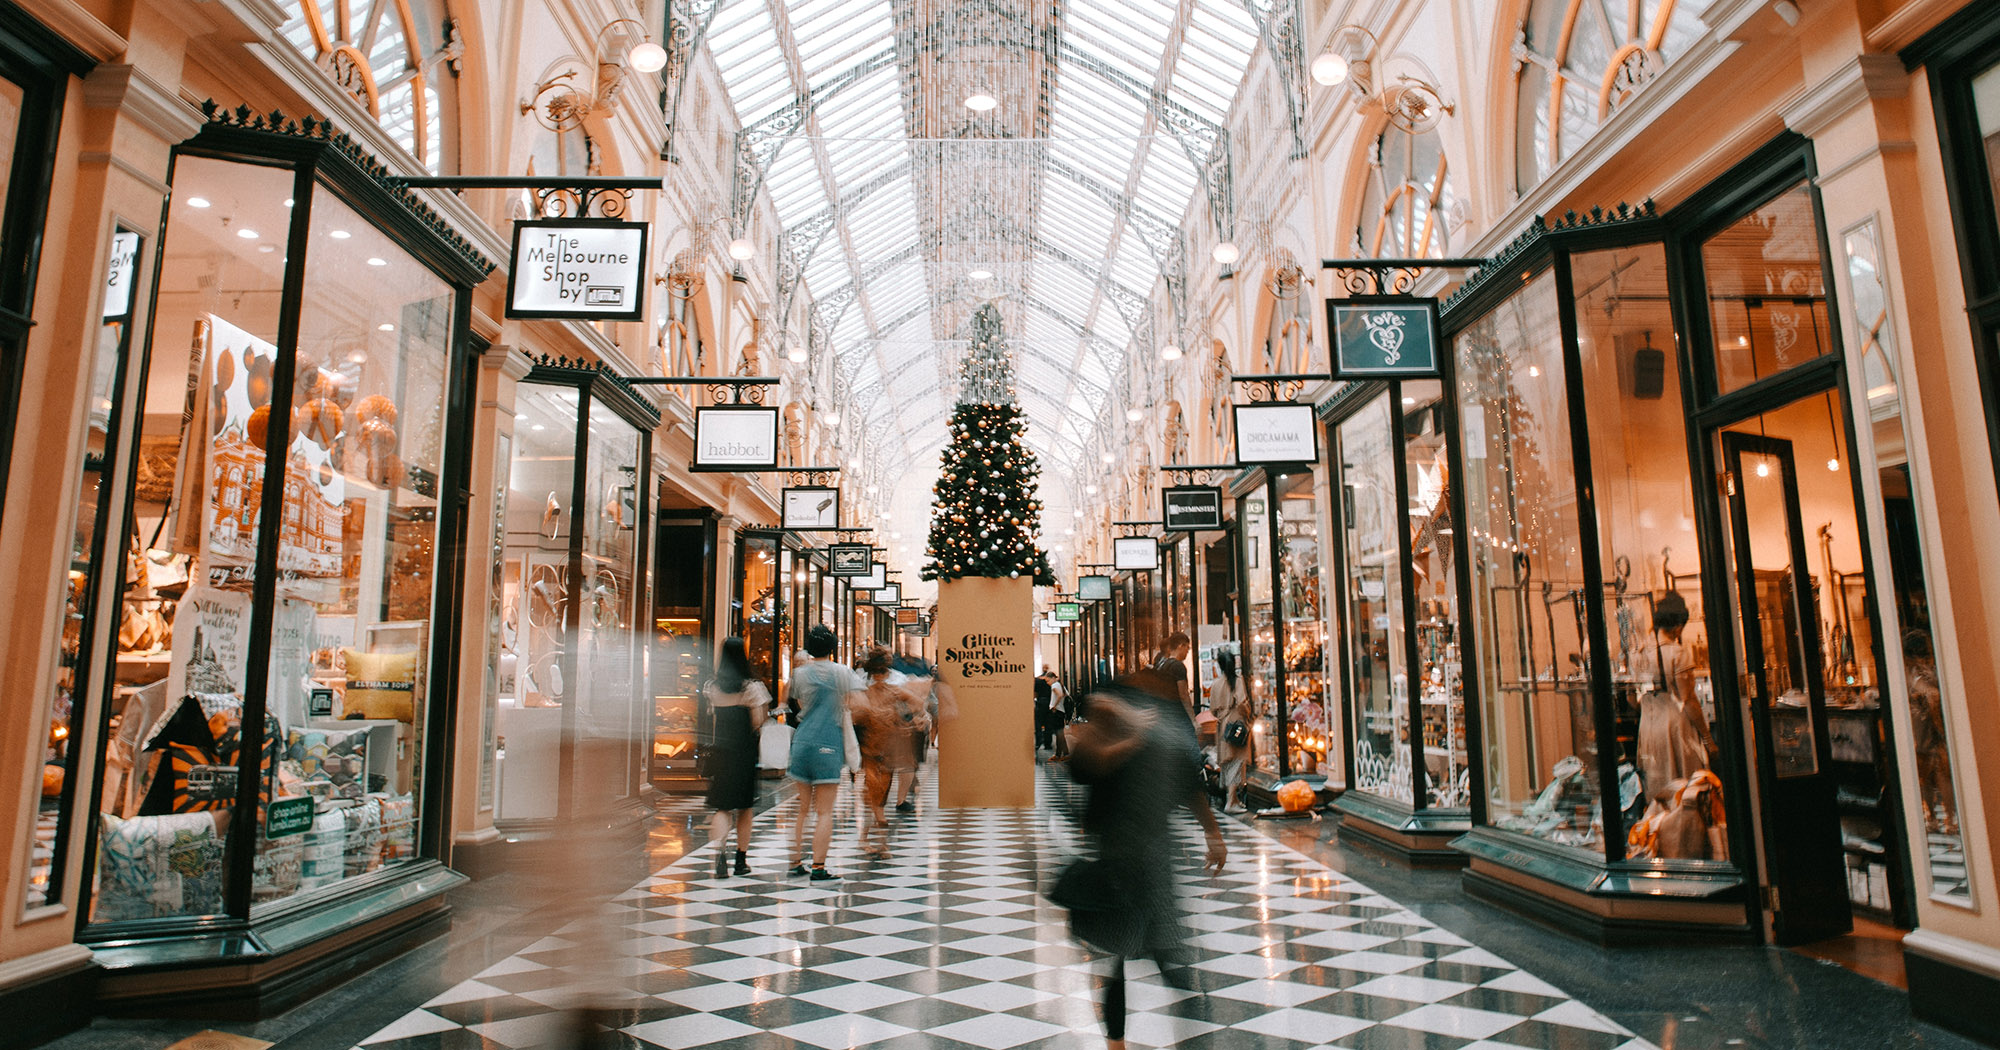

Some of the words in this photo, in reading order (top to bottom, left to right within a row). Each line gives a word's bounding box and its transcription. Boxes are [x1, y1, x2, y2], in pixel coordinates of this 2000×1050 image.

[547, 233, 579, 249] The
[527, 246, 629, 264] Melbourne
[543, 265, 590, 287] Shop
[559, 284, 582, 303] by
[1247, 432, 1300, 443] CHOCAMAMA
[708, 442, 764, 456] habbot.
[961, 633, 1016, 649] Glitter.
[945, 647, 1004, 663] Sparkle
